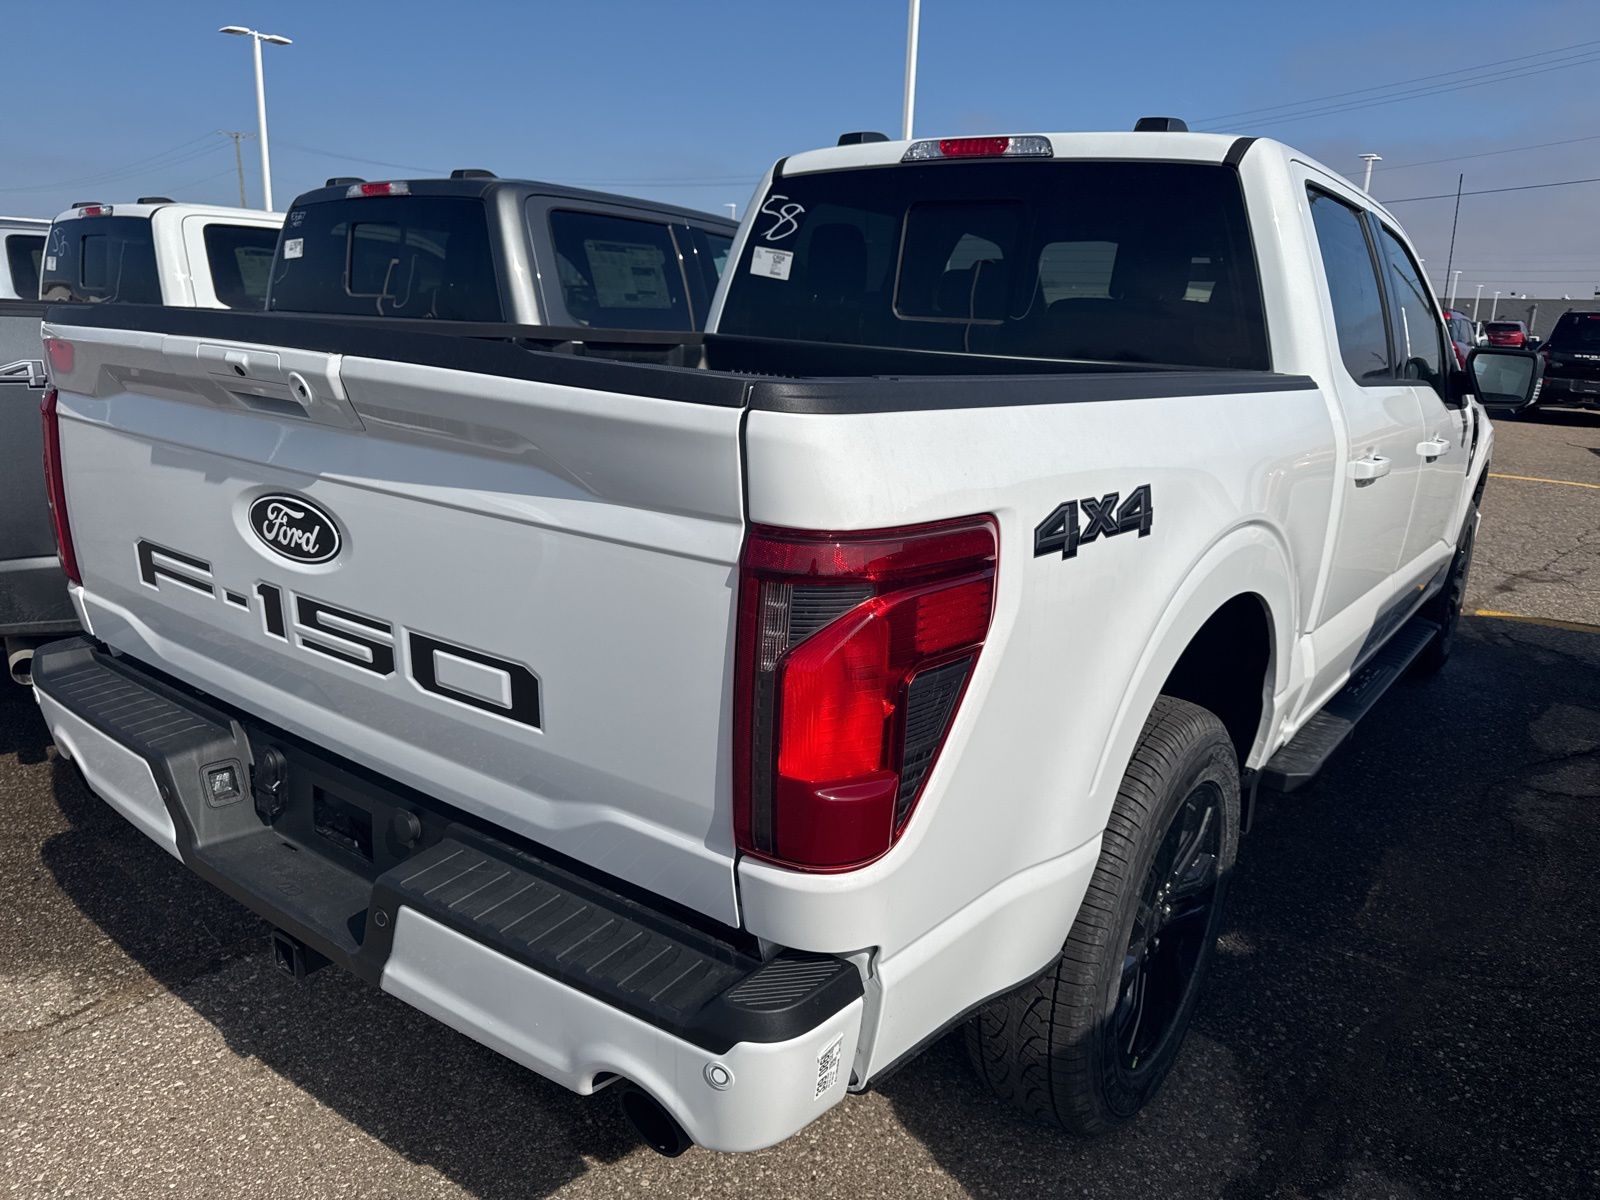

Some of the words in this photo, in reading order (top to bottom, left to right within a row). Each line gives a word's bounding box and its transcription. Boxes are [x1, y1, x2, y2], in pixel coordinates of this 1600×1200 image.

[761, 194, 806, 241] 58
[262, 502, 320, 554] Ford
[133, 537, 544, 734] F-150
